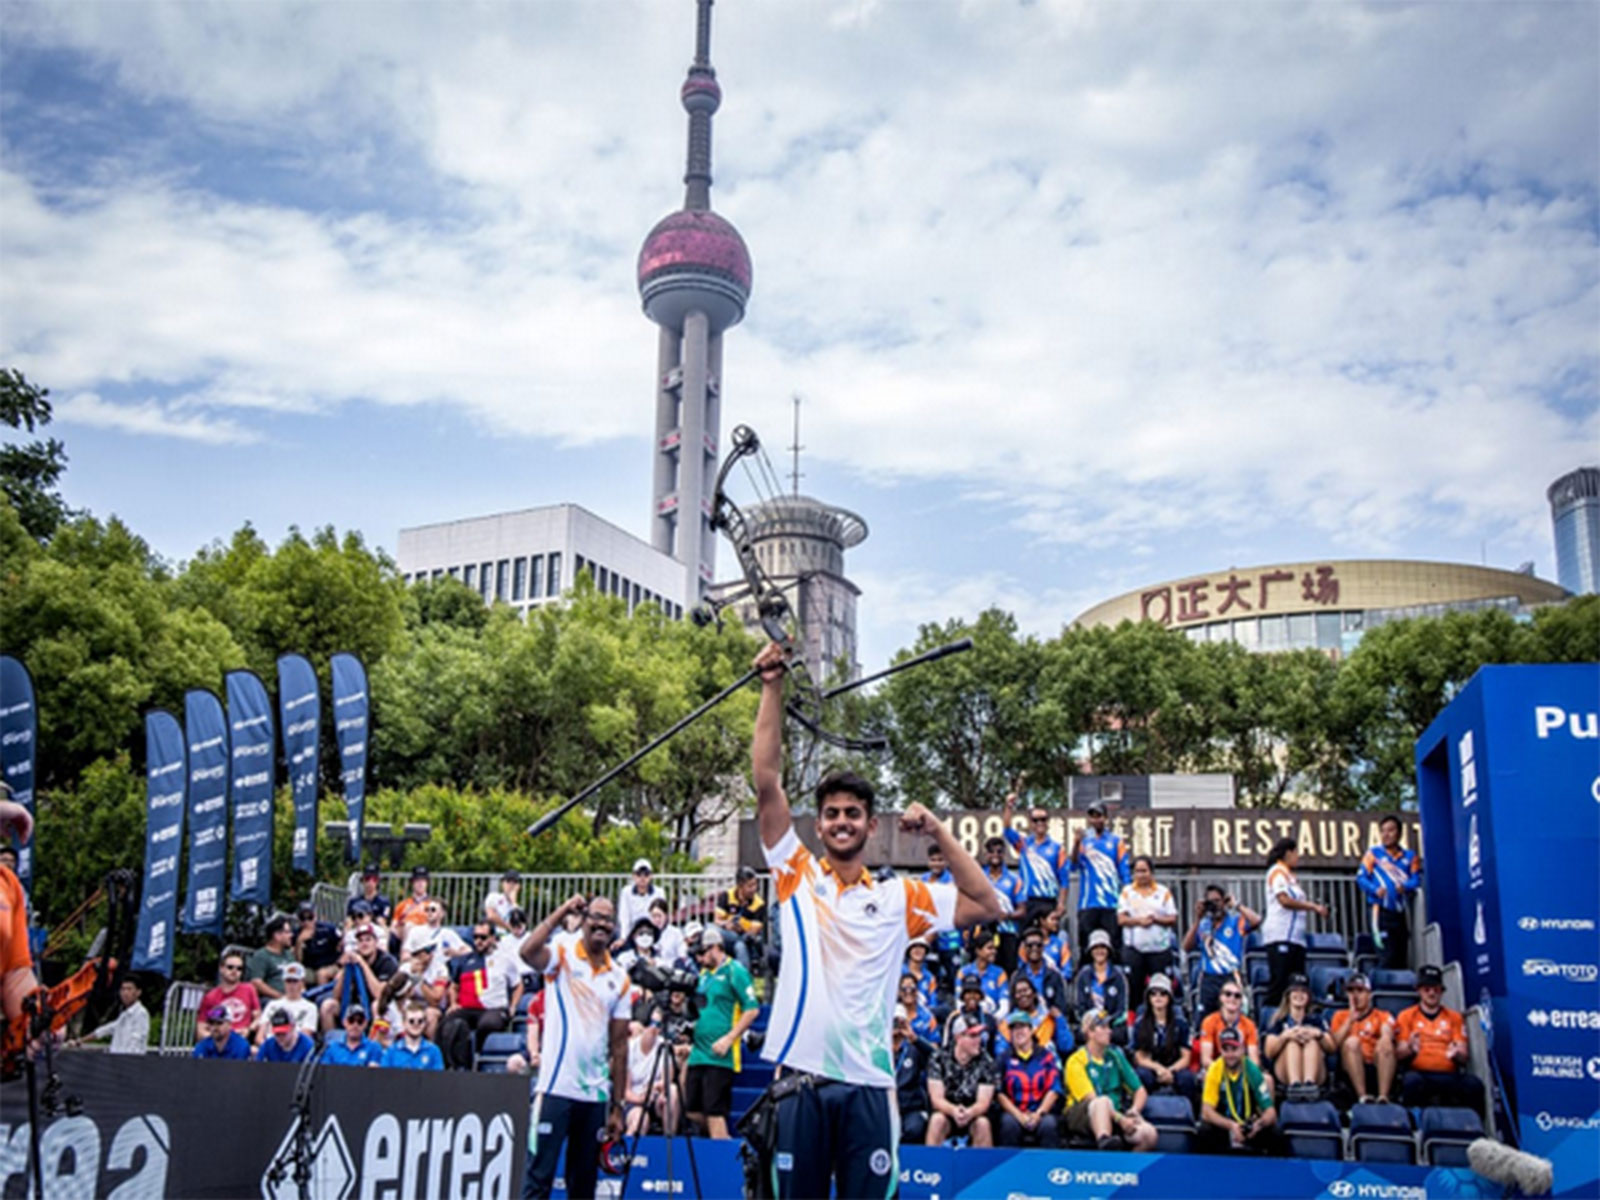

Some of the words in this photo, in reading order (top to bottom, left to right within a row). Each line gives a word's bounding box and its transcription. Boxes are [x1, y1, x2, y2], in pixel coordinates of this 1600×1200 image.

[1176, 567, 1340, 622] 正大广场
[361, 1114, 515, 1200] errea
[913, 1169, 942, 1187] Cup
[1075, 1171, 1139, 1186] HYUNDAI
